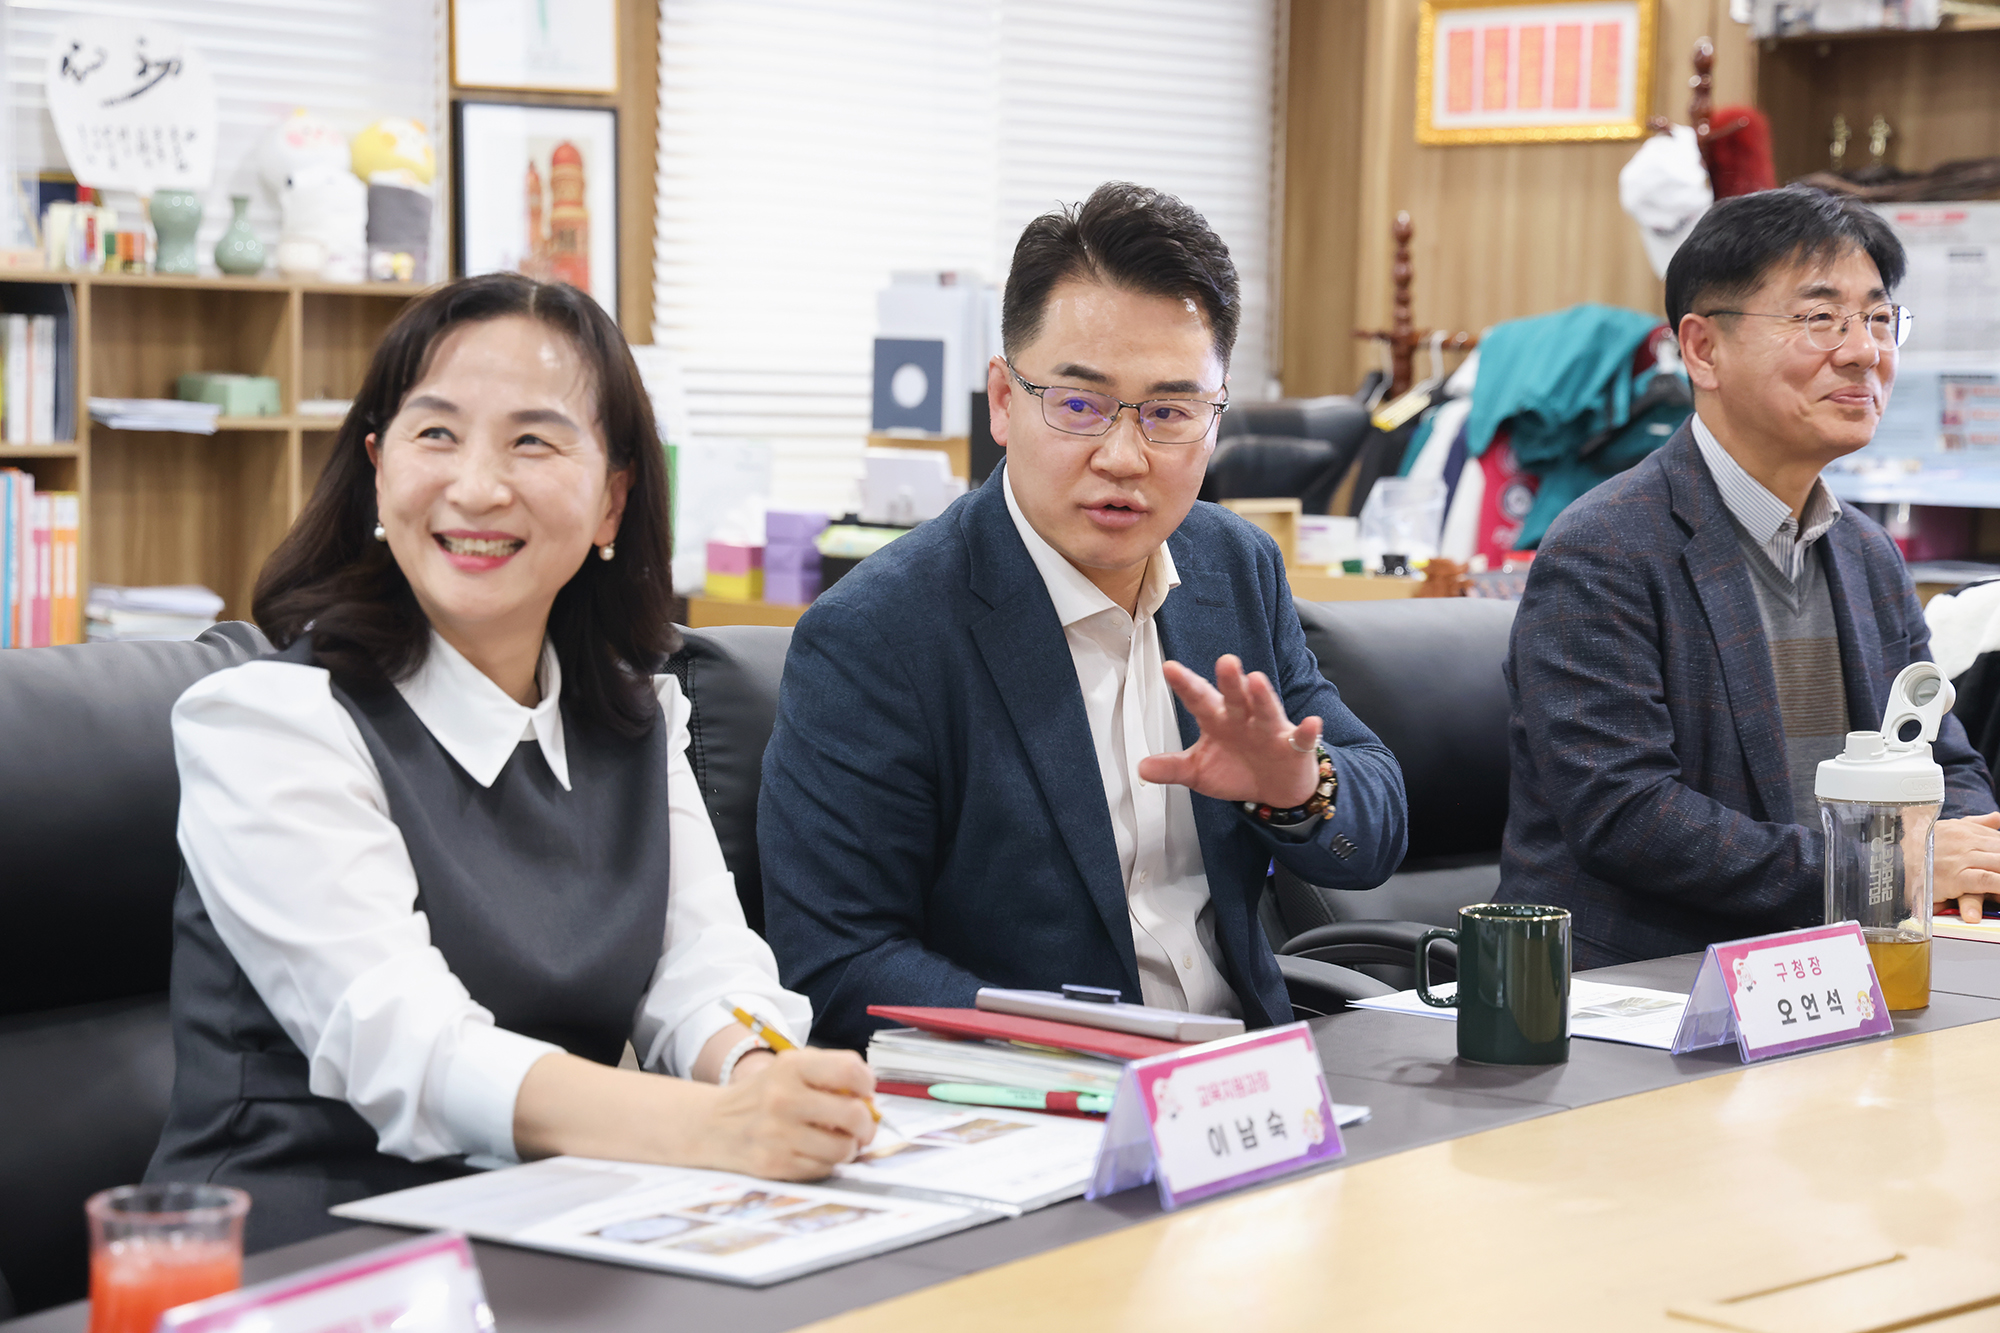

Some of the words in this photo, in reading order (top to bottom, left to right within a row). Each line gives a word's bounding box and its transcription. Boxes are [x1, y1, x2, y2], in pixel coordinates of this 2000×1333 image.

[1774, 956, 1822, 982] 구청장
[1777, 988, 1845, 1025] 오언석
[1208, 1110, 1288, 1156] 이남숙
